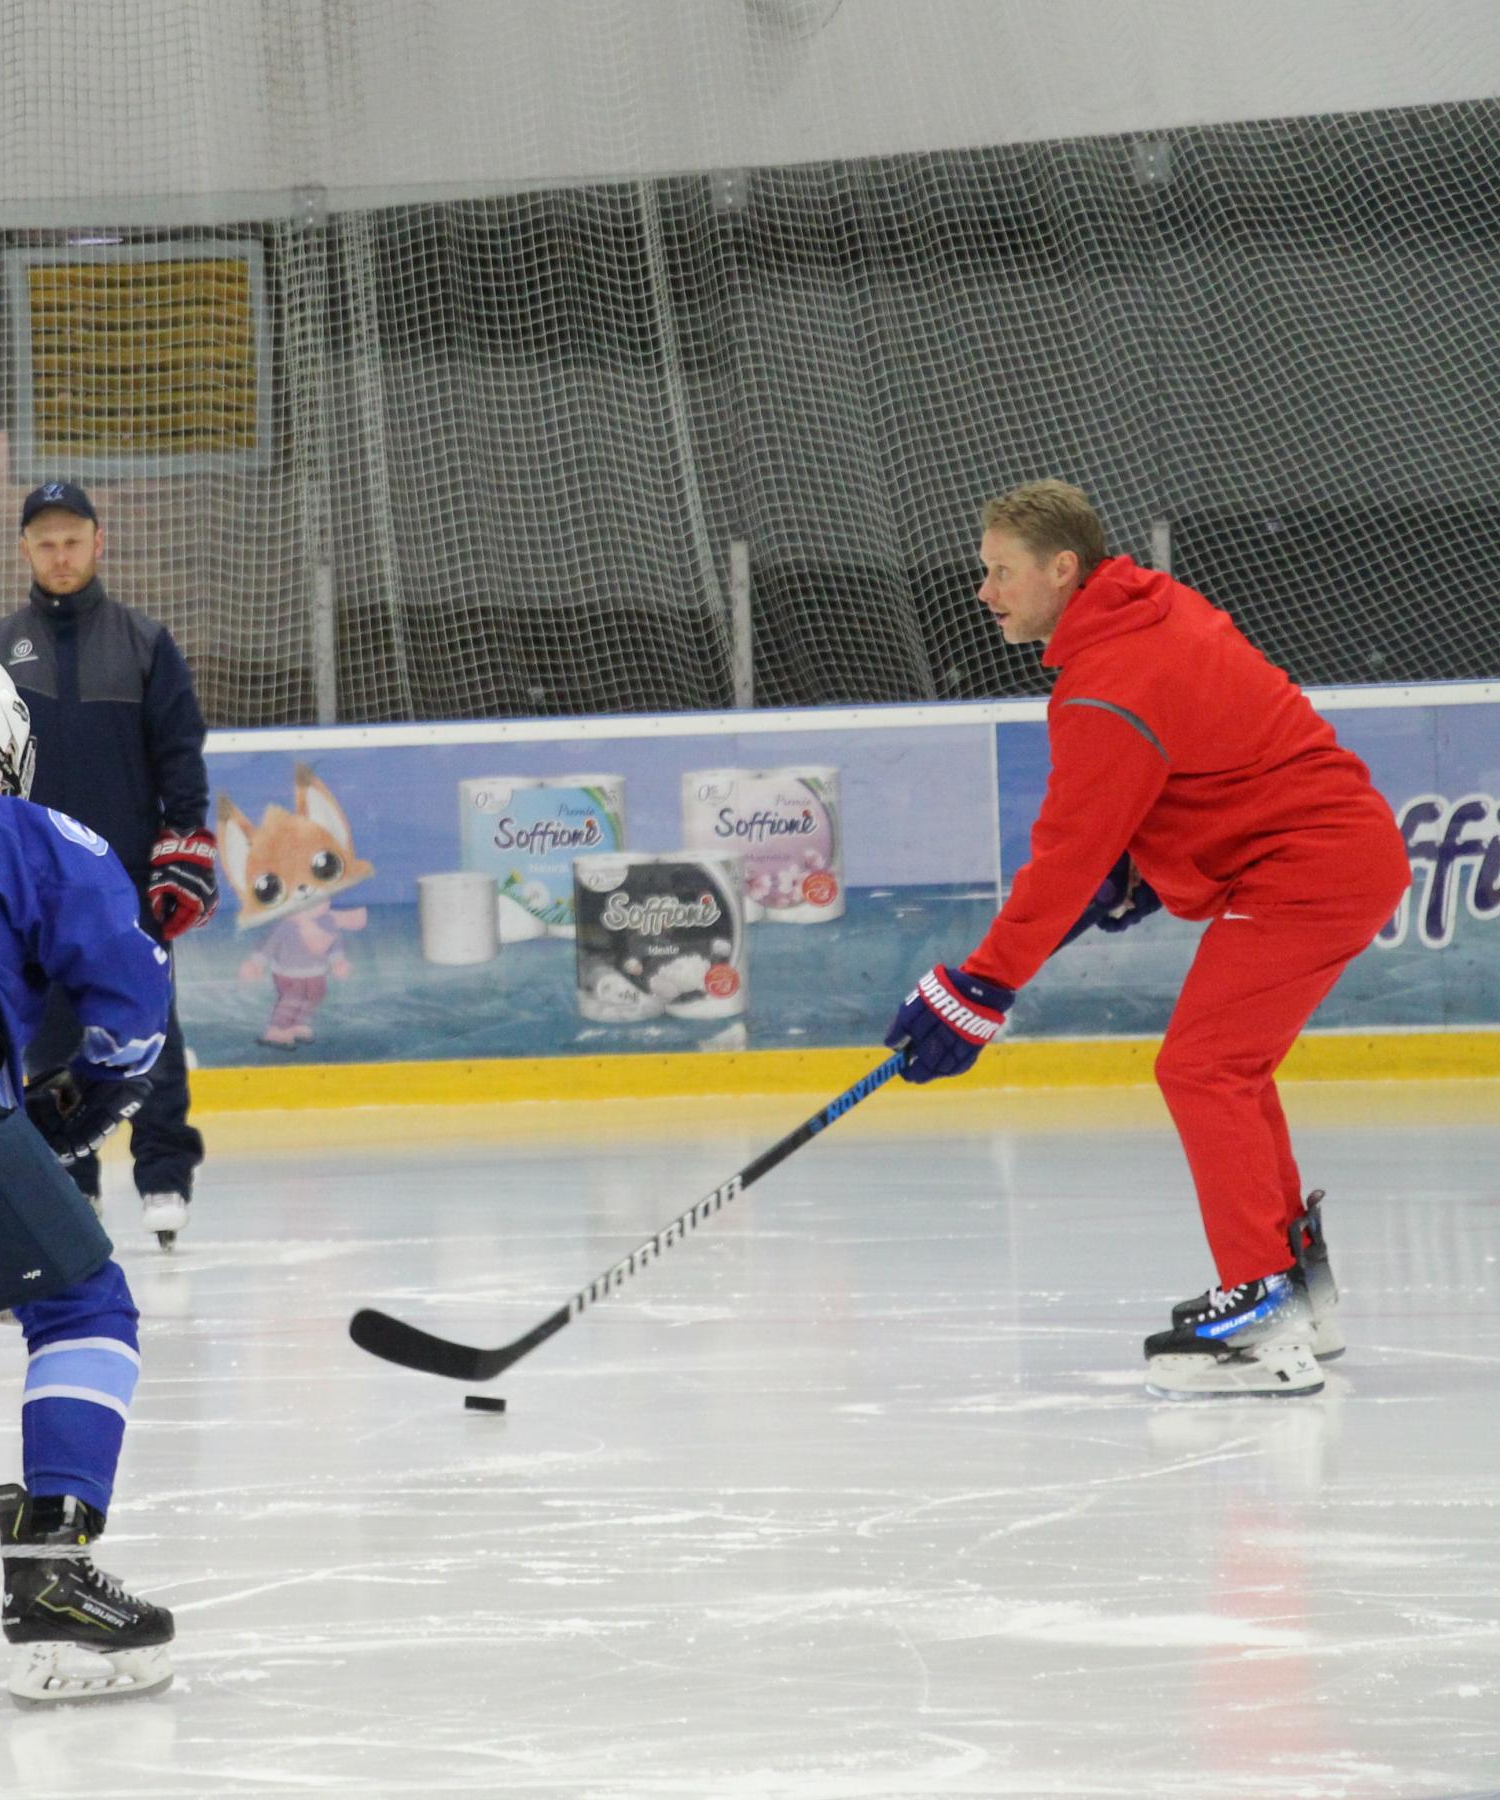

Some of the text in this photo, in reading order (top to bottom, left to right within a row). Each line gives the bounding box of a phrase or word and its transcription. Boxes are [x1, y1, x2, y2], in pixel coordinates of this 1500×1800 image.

[918, 969, 1001, 1040] WARRIOR
[568, 1173, 744, 1318] WARRIOR
[82, 1601, 126, 1629] BAUER
